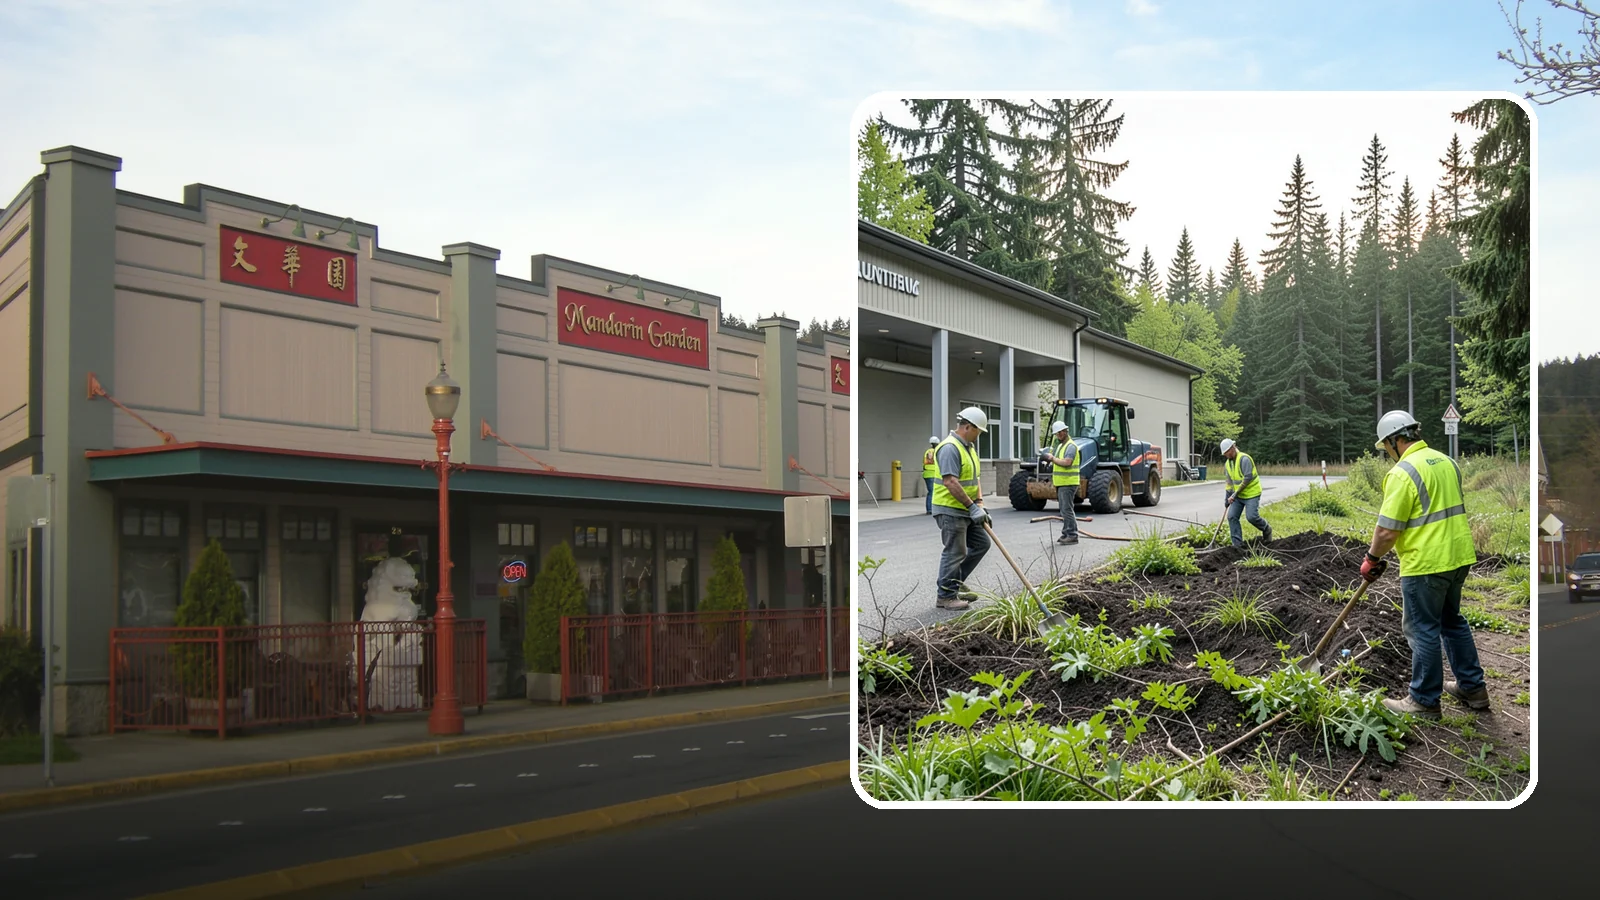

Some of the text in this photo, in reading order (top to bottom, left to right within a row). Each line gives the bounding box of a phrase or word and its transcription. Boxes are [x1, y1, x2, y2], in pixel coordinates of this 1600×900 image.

[564, 302, 701, 352] Mandarin Garden
[503, 565, 527, 578] OPEN
